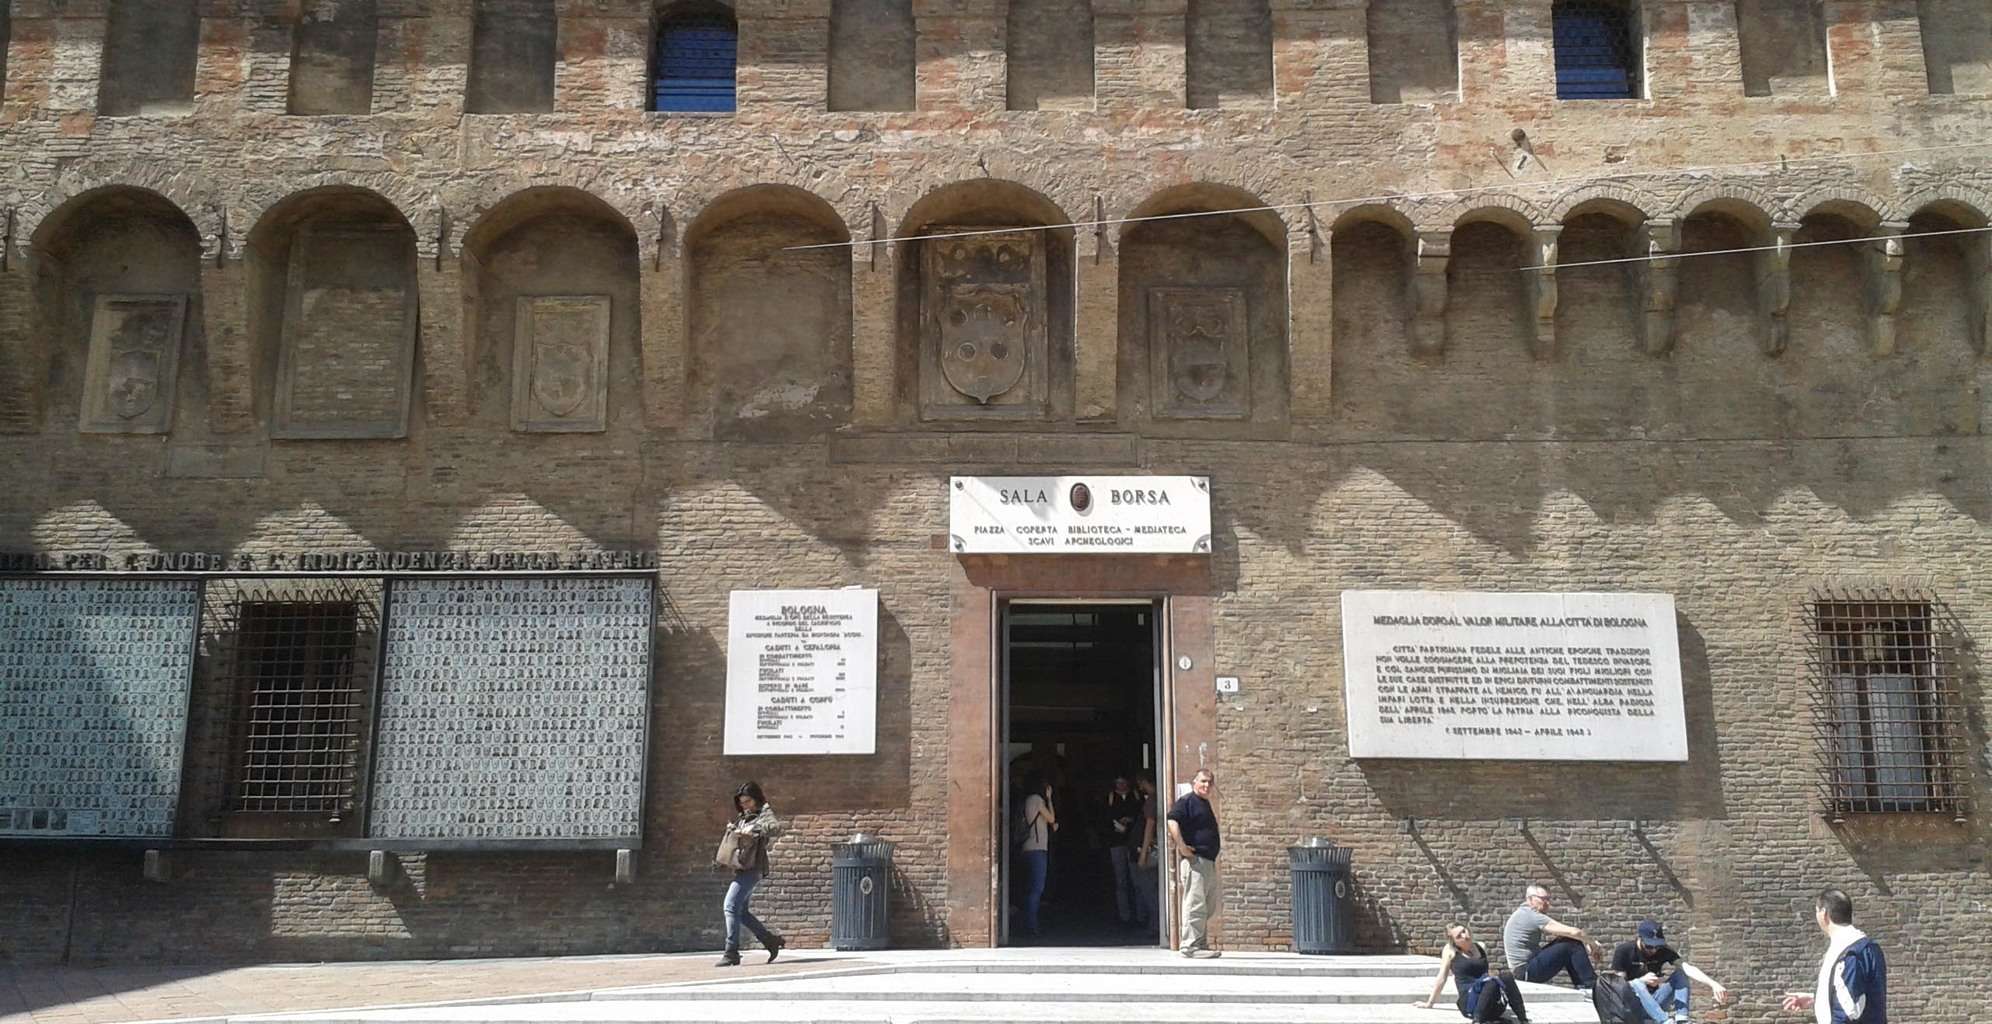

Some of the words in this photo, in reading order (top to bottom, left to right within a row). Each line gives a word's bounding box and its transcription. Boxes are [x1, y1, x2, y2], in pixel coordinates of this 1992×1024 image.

[1000, 489, 1048, 504] SALA
[1111, 489, 1170, 505] BORSA
[974, 526, 1005, 534] PIAZZA
[1016, 526, 1057, 534] COPERTA
[1068, 526, 1121, 534] BIBLIOTECA
[1134, 526, 1187, 534] MEDIATECA
[1028, 537, 1054, 545] SCAVI
[781, 605, 828, 614] BOLOGNA
[1373, 616, 1421, 625] MEDAGLIA
[1463, 616, 1492, 626] VALOR
[1495, 616, 1538, 627] MILITARE
[1540, 617, 1564, 627] ALLA
[1604, 617, 1648, 628] BOLOGNA
[1470, 646, 1501, 654] FEDELE
[1530, 647, 1563, 655] ANTICHE
[1394, 656, 1420, 664] VOLLE
[1385, 665, 1402, 673] COL
[1224, 680, 1231, 689] 3
[1398, 685, 1409, 694] LE
[1482, 686, 1493, 695] AL
[1531, 687, 1542, 695] FU
[1409, 695, 1435, 704] LOTTA
[1449, 696, 1477, 705] NELLA
[1404, 705, 1434, 714] APRILE
[1492, 706, 1503, 715] LA
[1506, 707, 1534, 715] PATRIA
[1540, 707, 1561, 716] ALLA
[1627, 708, 1655, 717] DELLA
